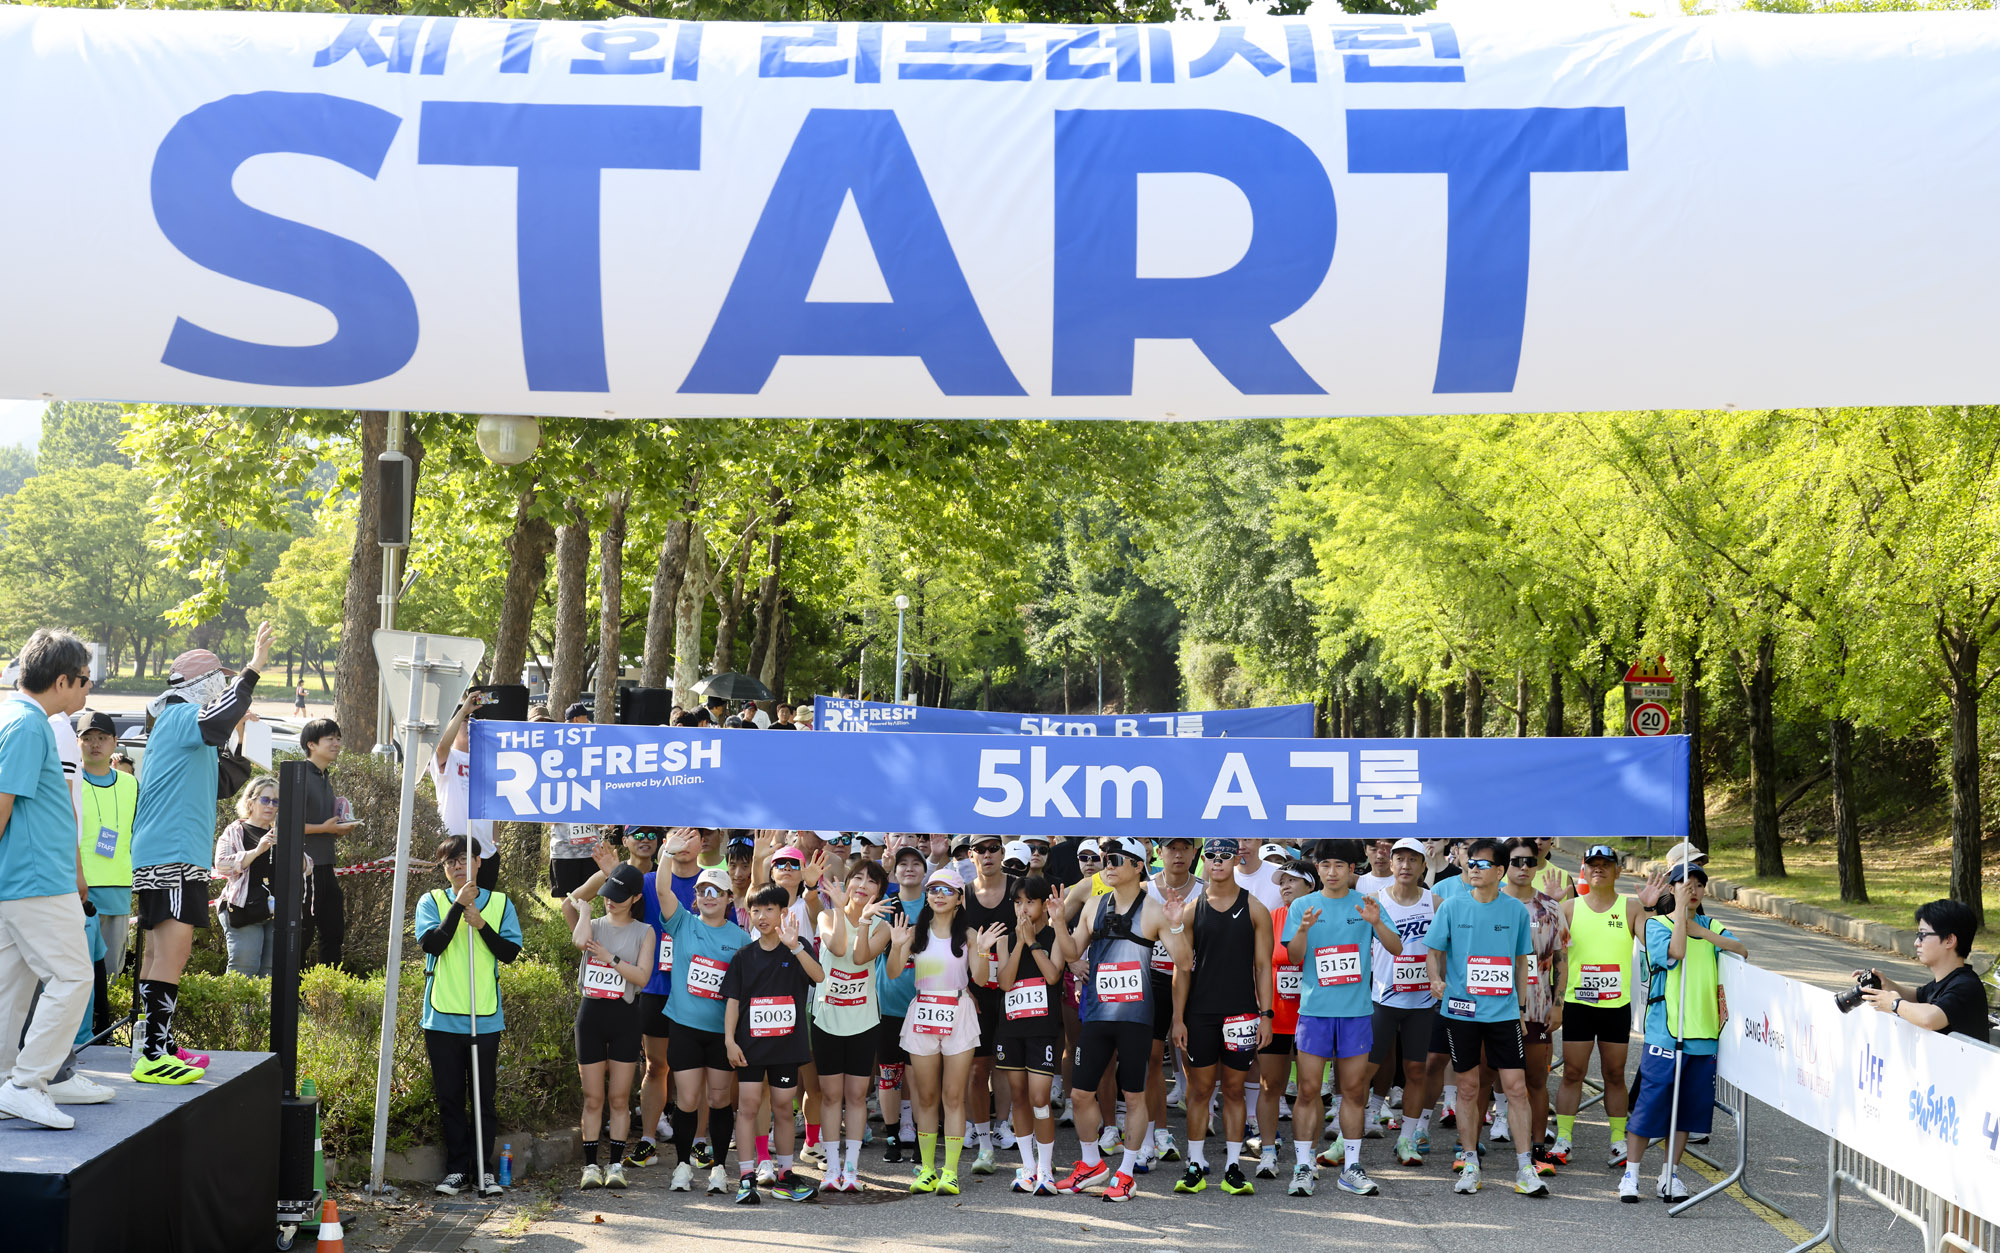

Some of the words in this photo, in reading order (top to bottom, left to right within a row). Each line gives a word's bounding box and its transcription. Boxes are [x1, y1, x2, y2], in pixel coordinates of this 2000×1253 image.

[151, 90, 1628, 396] START
[1020, 717, 1097, 736] 5km
[1115, 719, 1139, 736] B
[1641, 712, 1660, 727] 20
[496, 730, 545, 748] THE
[554, 726, 597, 746] 1ST
[605, 778, 648, 790] Powered
[649, 776, 662, 788] by
[972, 746, 1163, 819] 5km
[1200, 752, 1268, 820] A
[1285, 749, 1422, 824] 그룹
[97, 841, 115, 852] STAFF
[1152, 945, 1169, 957] 52
[1320, 957, 1357, 972] 5157
[589, 970, 623, 987] 7020
[1396, 967, 1428, 980] 5073
[1471, 969, 1509, 983] 5258
[830, 982, 866, 995] 5257
[1099, 975, 1138, 989] 5016
[1280, 976, 1303, 989] 52
[1583, 976, 1618, 988] 5592
[1008, 991, 1043, 1007] 5013
[754, 1010, 793, 1023] 5003
[917, 1008, 954, 1022] 5163
[1045, 1044, 1053, 1062] 6
